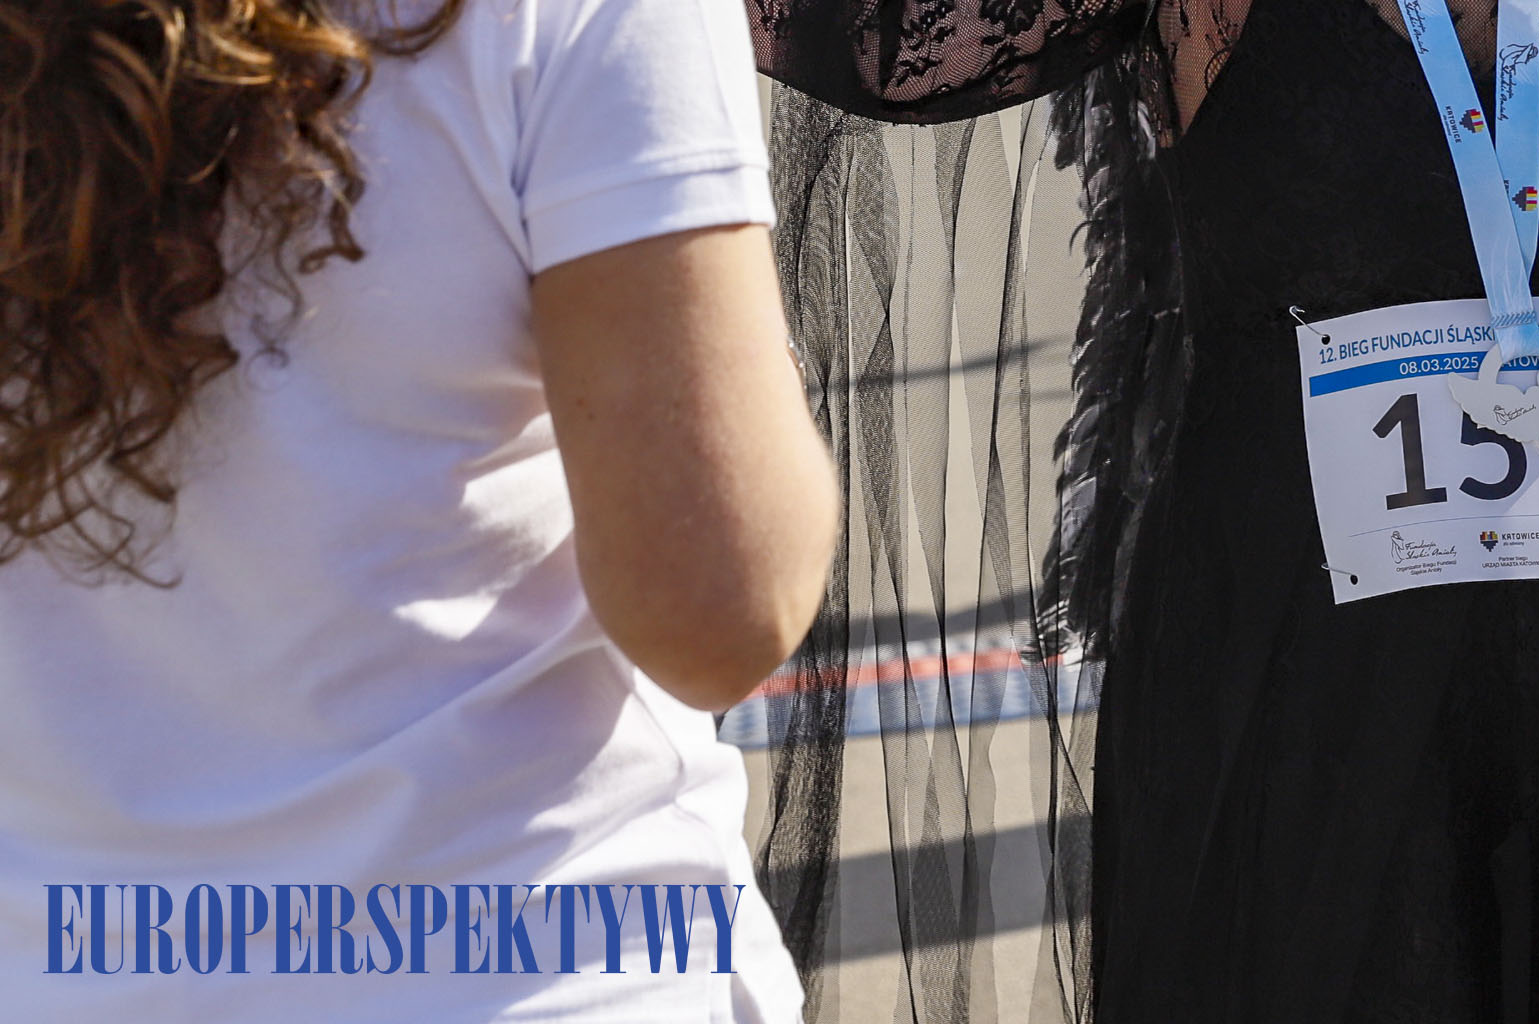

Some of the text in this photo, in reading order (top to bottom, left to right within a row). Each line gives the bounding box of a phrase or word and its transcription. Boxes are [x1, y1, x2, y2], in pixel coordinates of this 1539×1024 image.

[1445, 105, 1462, 144] KATOWICE
[1318, 347, 1337, 365] 12.
[1339, 339, 1369, 360] BIEG
[1371, 328, 1444, 353] FUNDACJI
[1447, 324, 1496, 345] ŚLĄSKI
[1400, 355, 1479, 375] 08.03.2025
[1501, 532, 1539, 540] KATOWICE
